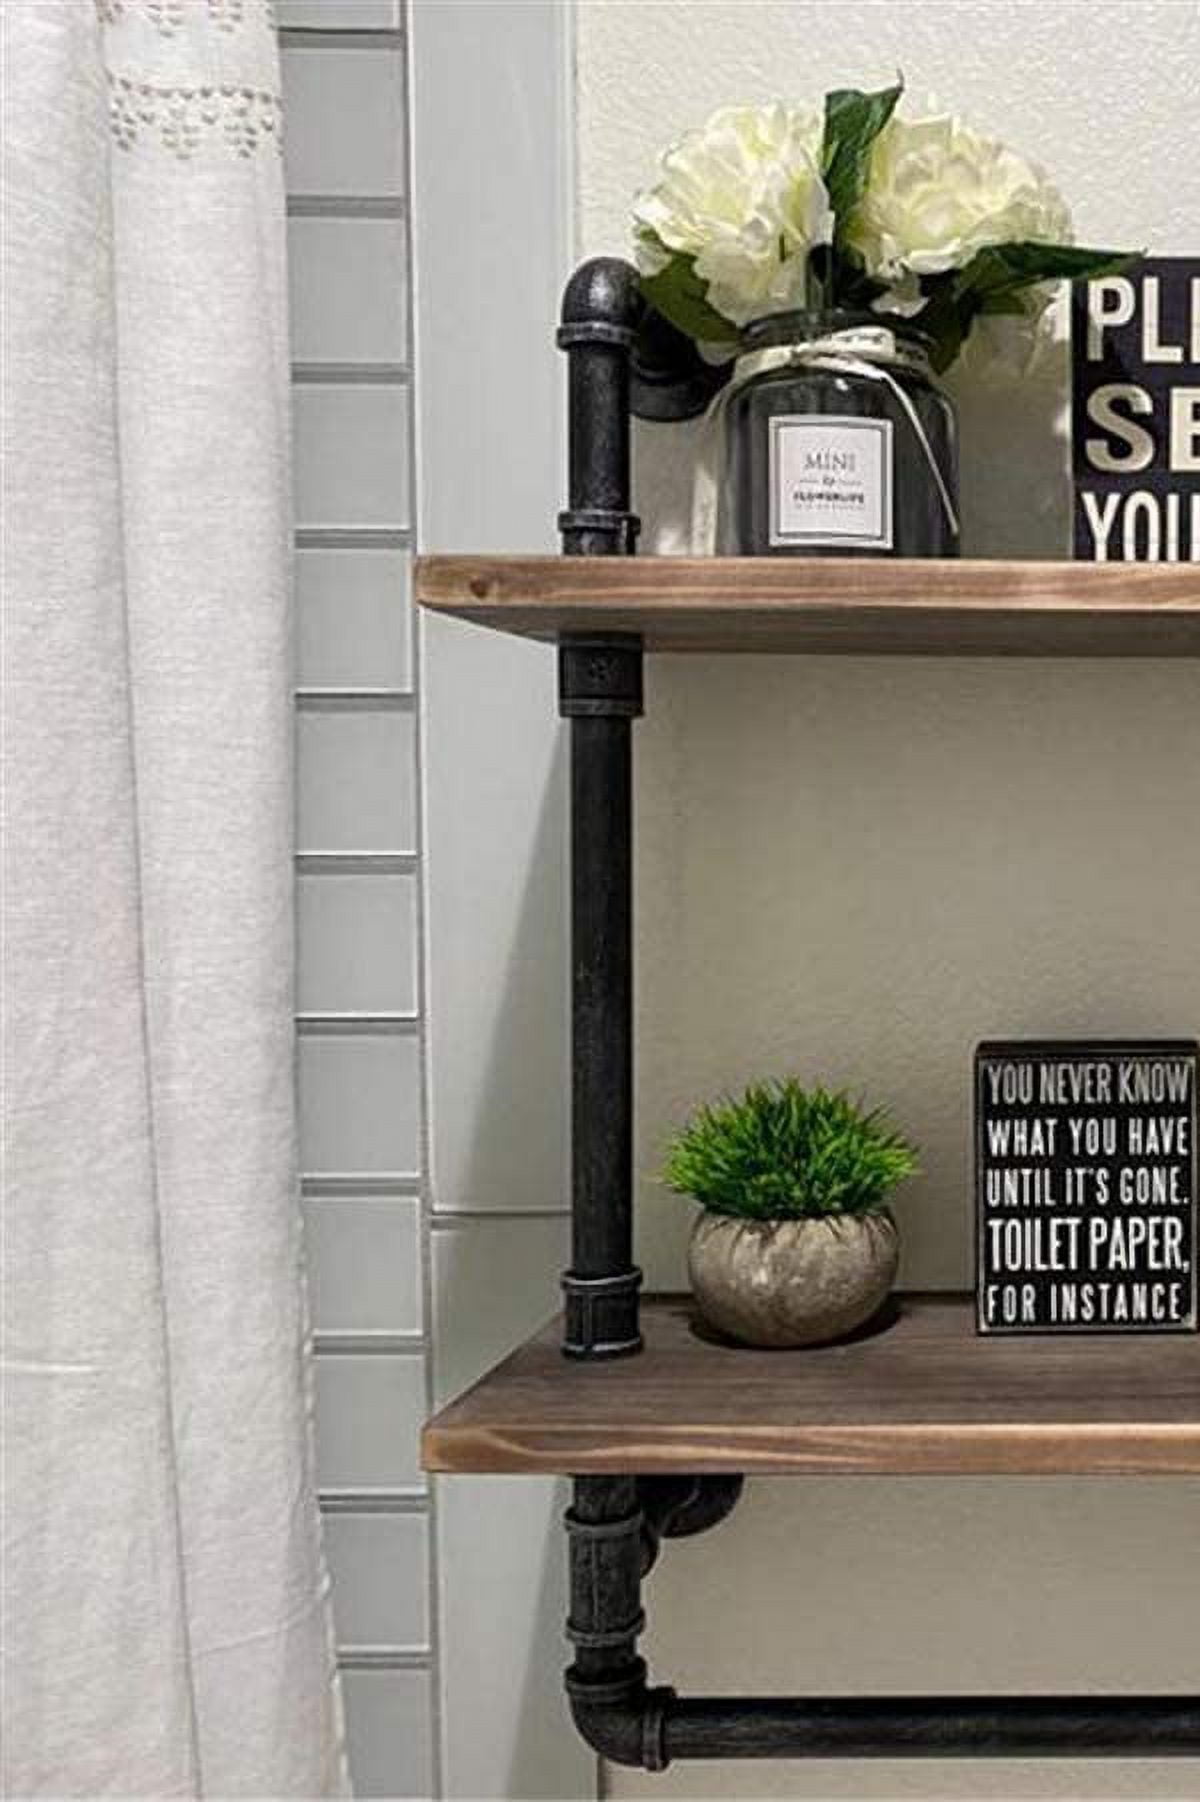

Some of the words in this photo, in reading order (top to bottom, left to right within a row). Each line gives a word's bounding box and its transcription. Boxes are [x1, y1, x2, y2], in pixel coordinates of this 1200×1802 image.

[987, 1062, 1033, 1105] YOU
[1039, 1062, 1112, 1104] NEVER
[1118, 1061, 1189, 1104] KNOW
[987, 1118, 1058, 1157] WHAT
[1068, 1117, 1117, 1156] YOU
[1128, 1116, 1189, 1156] HAVE
[986, 1168, 1056, 1207] UNTIL
[1064, 1167, 1110, 1206] IT'S
[1119, 1166, 1190, 1206] GONE.
[987, 1217, 1082, 1272] TOILET
[1089, 1216, 1190, 1274] PAPER,
[987, 1283, 1036, 1323] FOR
